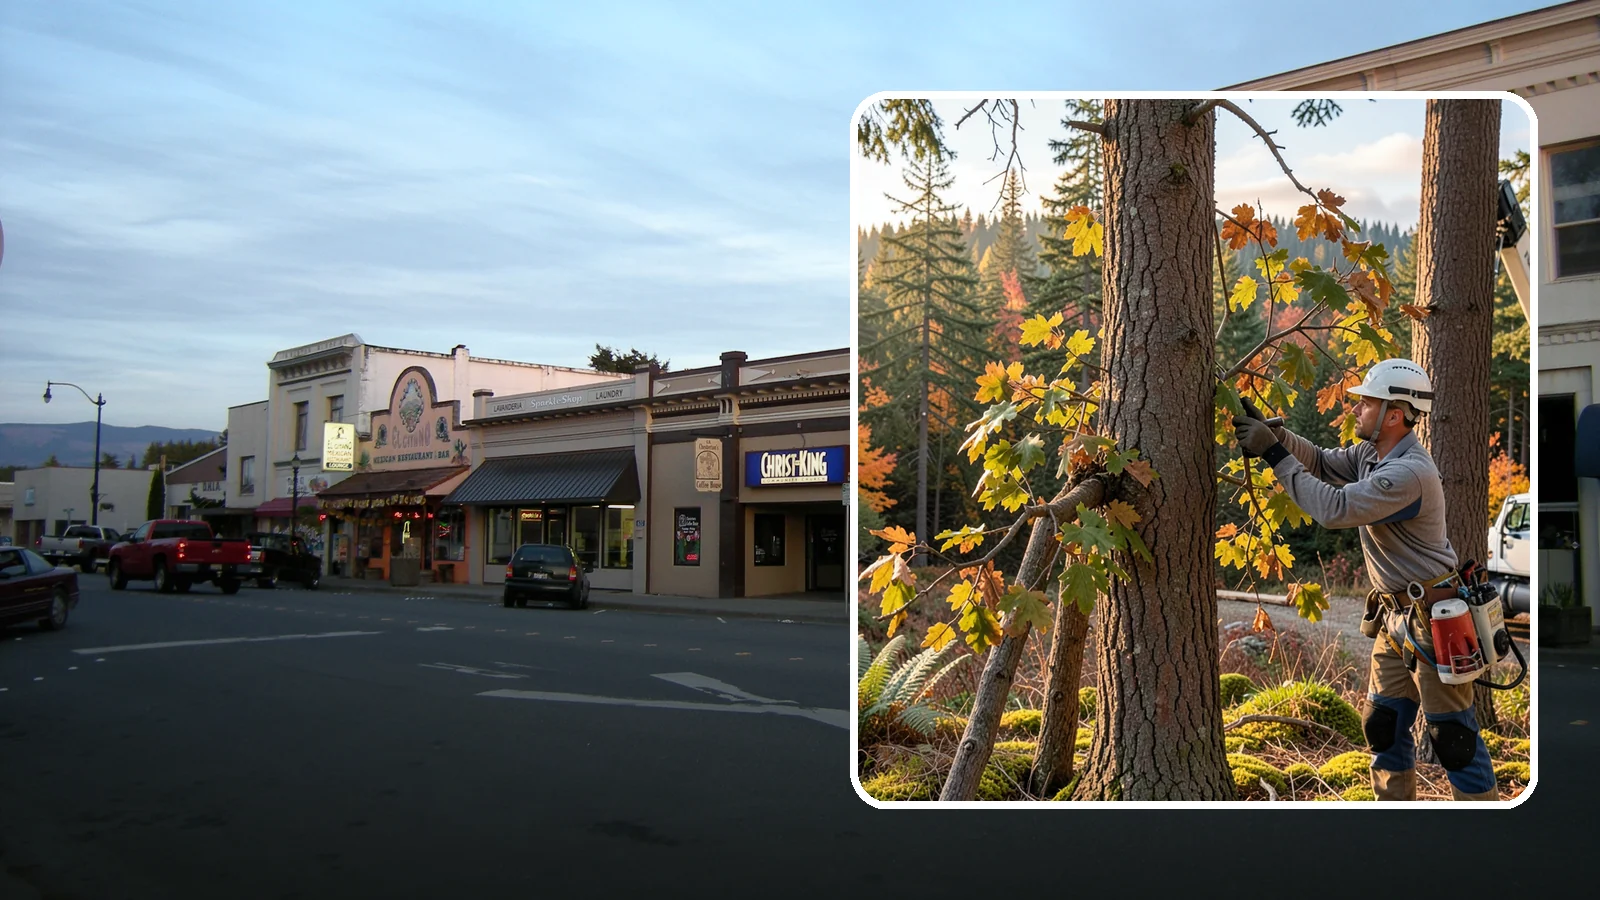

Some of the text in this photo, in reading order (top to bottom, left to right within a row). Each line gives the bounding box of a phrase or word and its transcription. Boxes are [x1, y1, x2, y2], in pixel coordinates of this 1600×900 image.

[561, 394, 583, 404] Shop
[595, 389, 623, 399] LAUNDRY
[494, 402, 522, 412] LAVANDERIA
[373, 455, 396, 464] MEXICAN
[397, 451, 433, 462] RESTAURANT
[438, 450, 450, 459] BAR
[761, 450, 827, 478] CHRIST KING
[696, 480, 709, 489] Coffee
